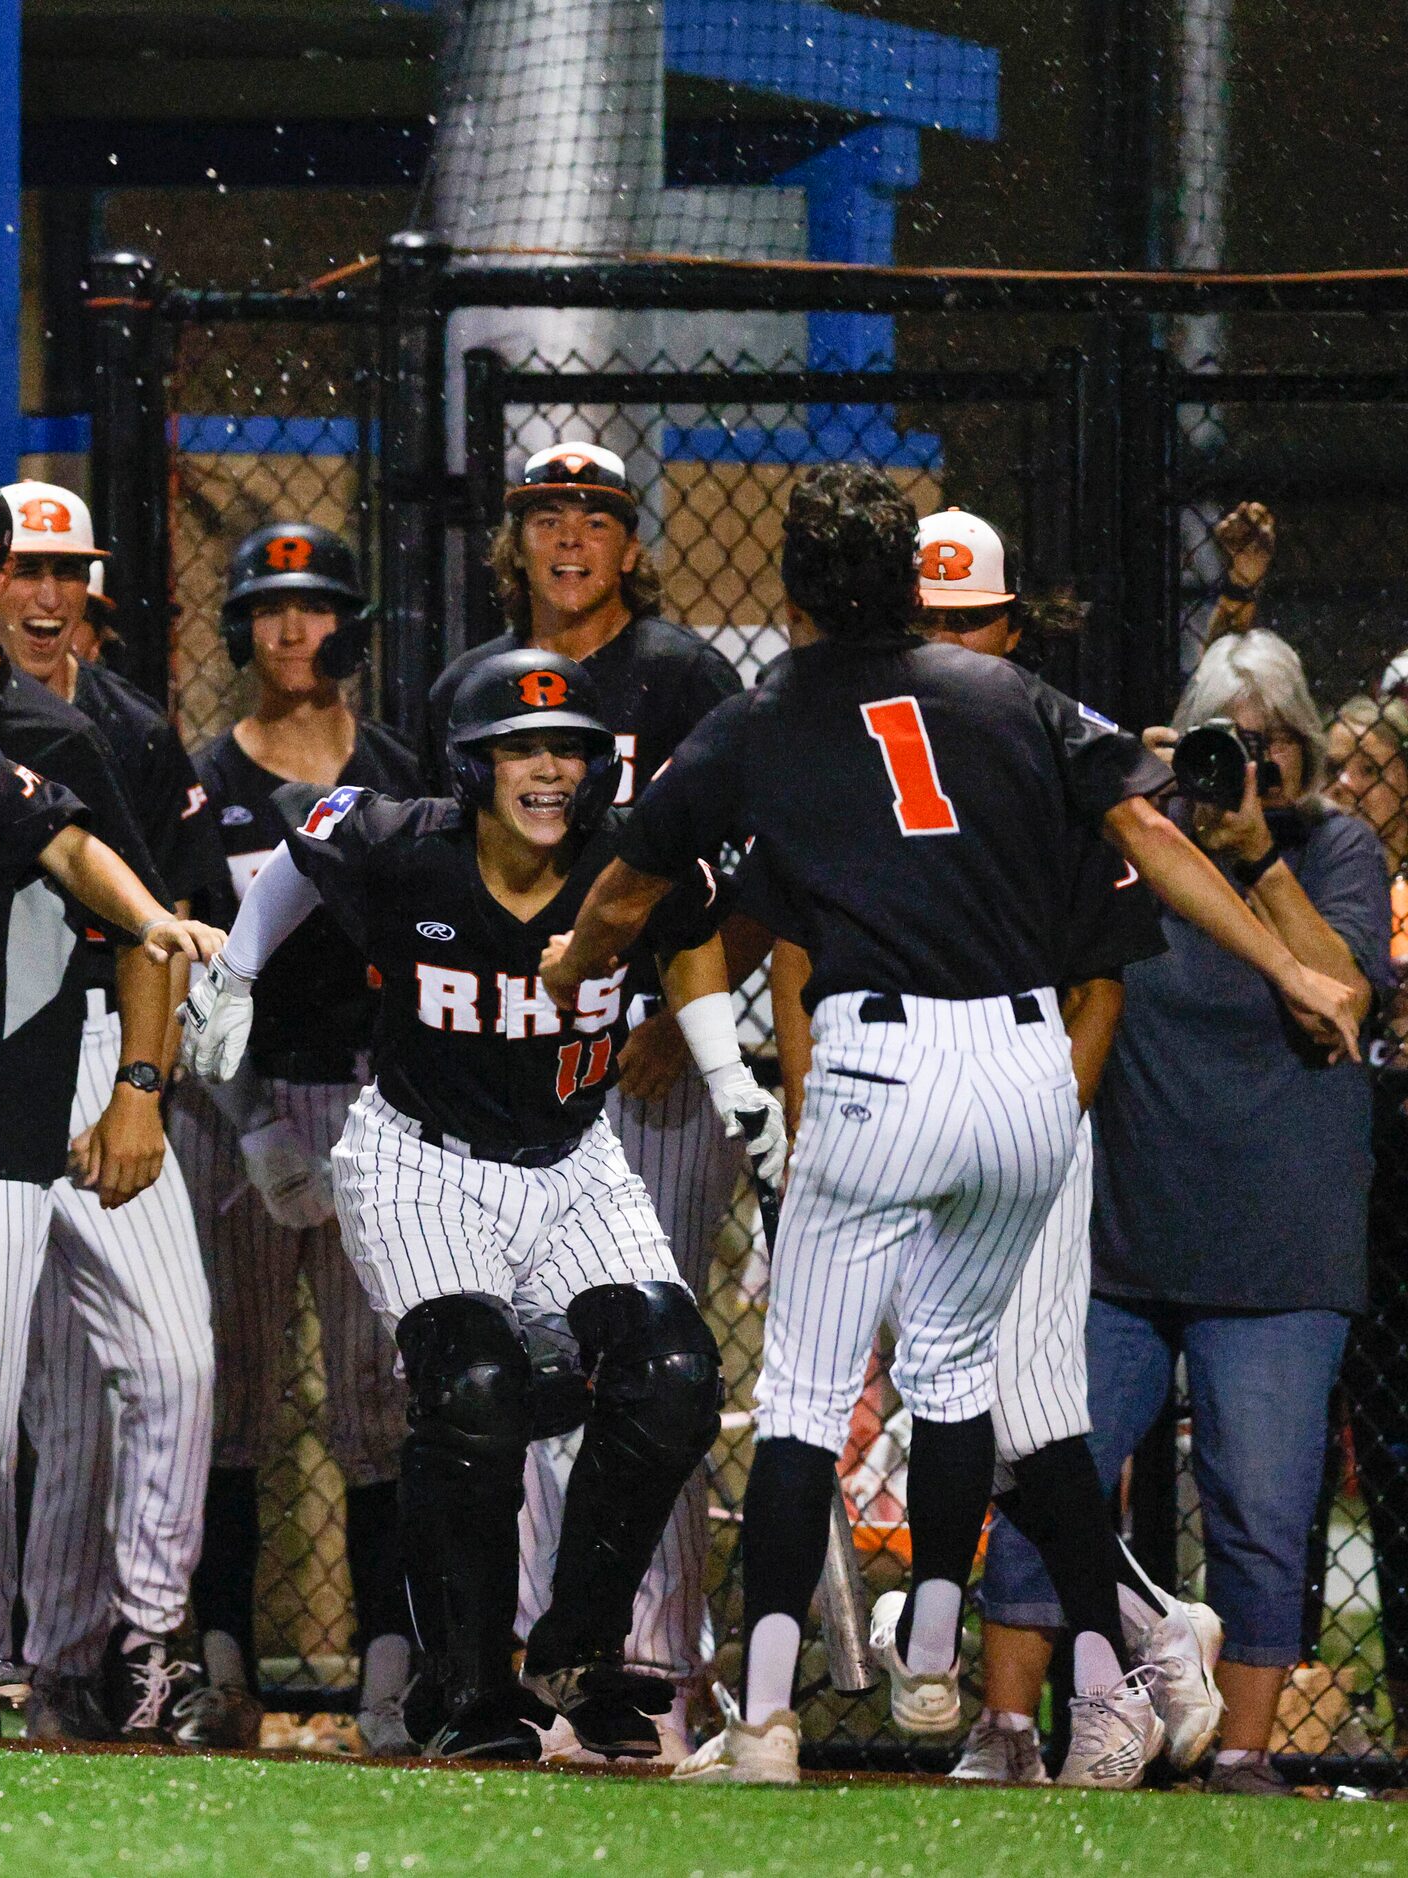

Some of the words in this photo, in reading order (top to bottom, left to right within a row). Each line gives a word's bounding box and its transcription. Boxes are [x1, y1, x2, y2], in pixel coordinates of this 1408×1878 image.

[18, 498, 72, 533] R
[265, 536, 313, 570] R
[920, 540, 973, 580] R
[517, 669, 568, 707] R
[860, 696, 960, 837] 1
[415, 962, 629, 1039] RHS
[556, 1034, 611, 1104] 11
